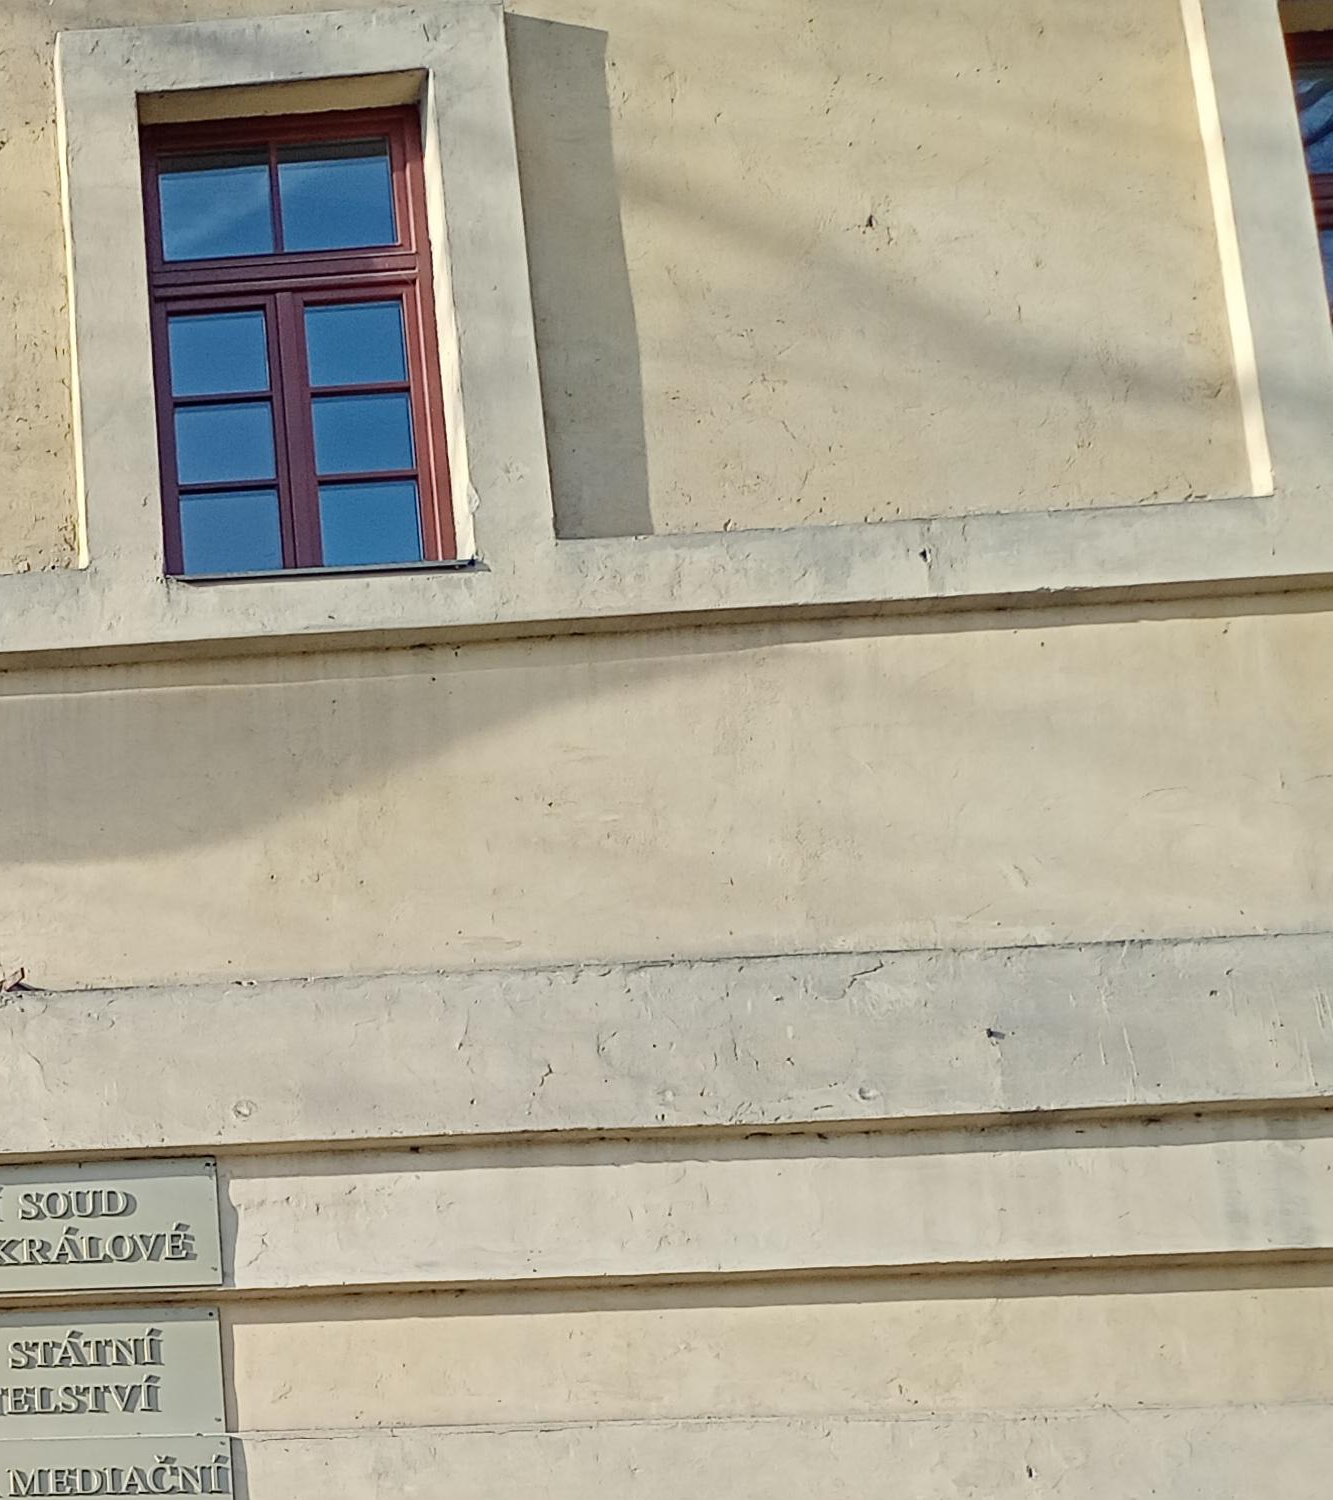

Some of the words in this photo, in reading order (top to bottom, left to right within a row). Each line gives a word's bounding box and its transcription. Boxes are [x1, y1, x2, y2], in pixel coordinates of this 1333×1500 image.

[17, 1188, 135, 1221] SOUD
[7, 1327, 164, 1369] STÁTNÍ
[9, 1454, 231, 1497] MEDIAČNÍ
